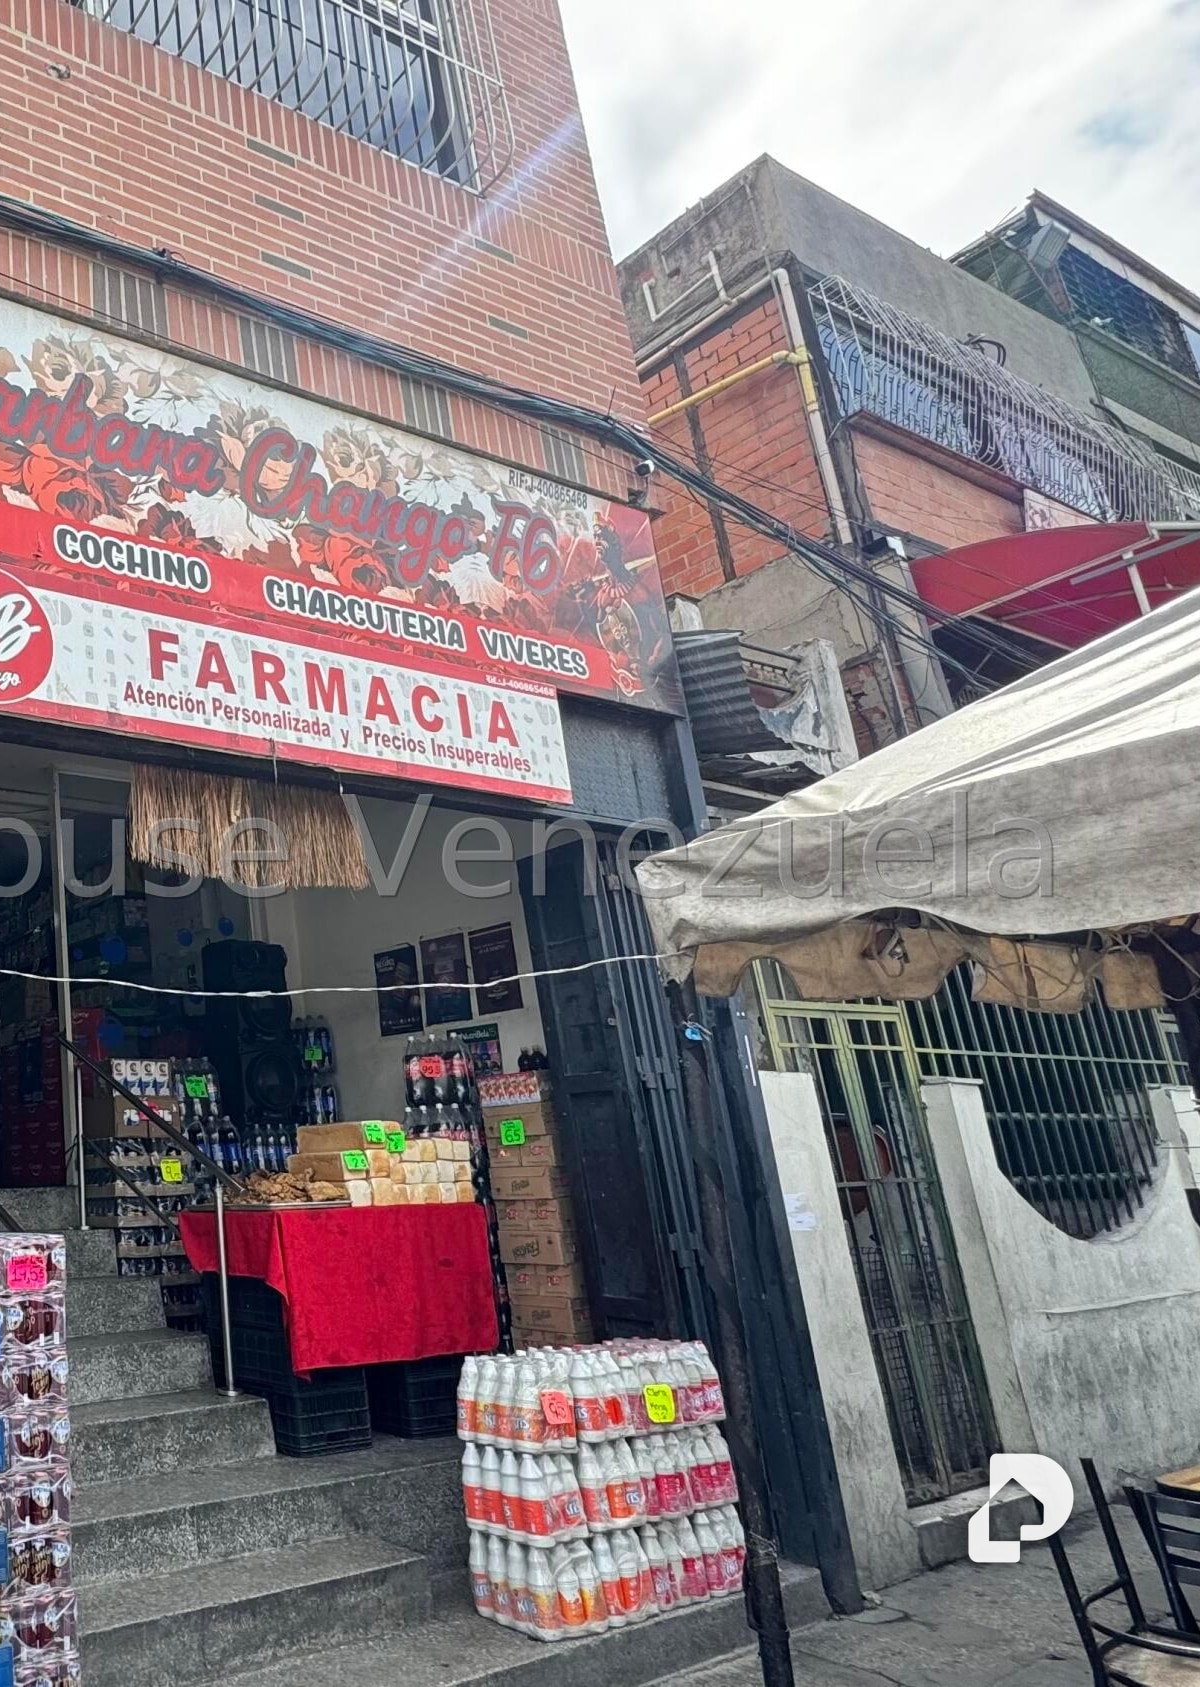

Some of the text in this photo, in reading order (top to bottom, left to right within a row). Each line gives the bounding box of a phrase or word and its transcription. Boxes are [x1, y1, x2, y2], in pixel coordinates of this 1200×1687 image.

[53, 524, 212, 593] COCHINO
[240, 427, 476, 587] Chango
[490, 500, 563, 596] F6
[263, 576, 589, 679] CHARCUTERIA VIVERES
[123, 681, 532, 774] Atención Personalizada y Precios Insuperables
[147, 628, 520, 748] FARMACIA
